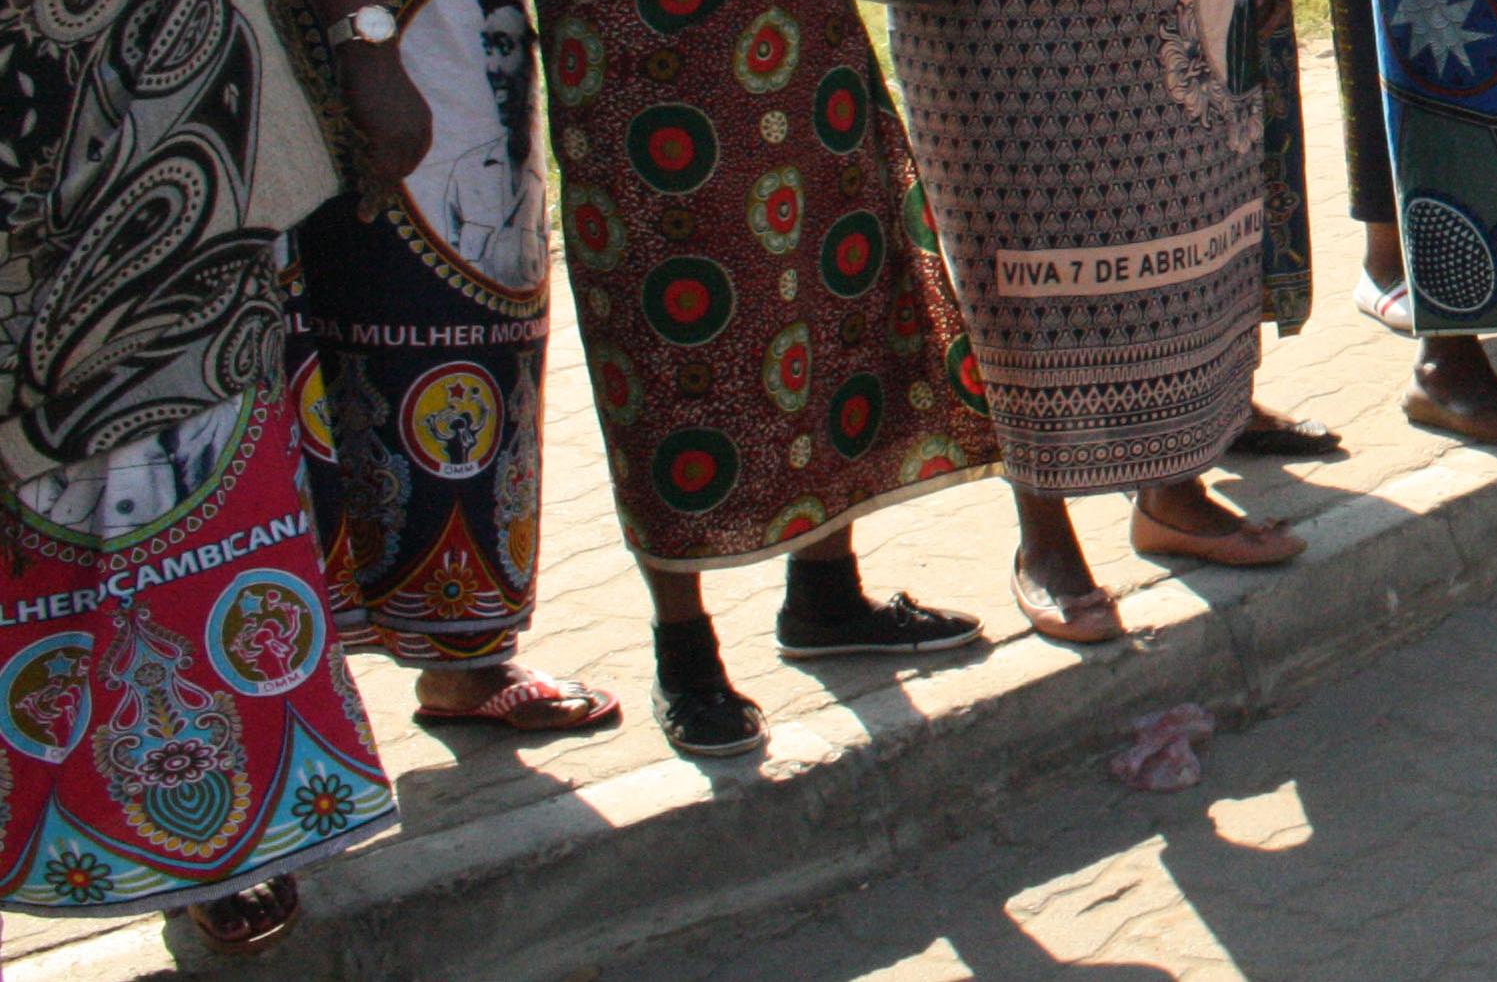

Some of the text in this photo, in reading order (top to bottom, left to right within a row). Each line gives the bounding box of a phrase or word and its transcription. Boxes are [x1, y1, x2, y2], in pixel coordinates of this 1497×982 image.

[1002, 261, 1062, 285] VIVA
[1070, 261, 1084, 284] 7
[1095, 257, 1129, 283] DE
[352, 323, 485, 346] MULHER
